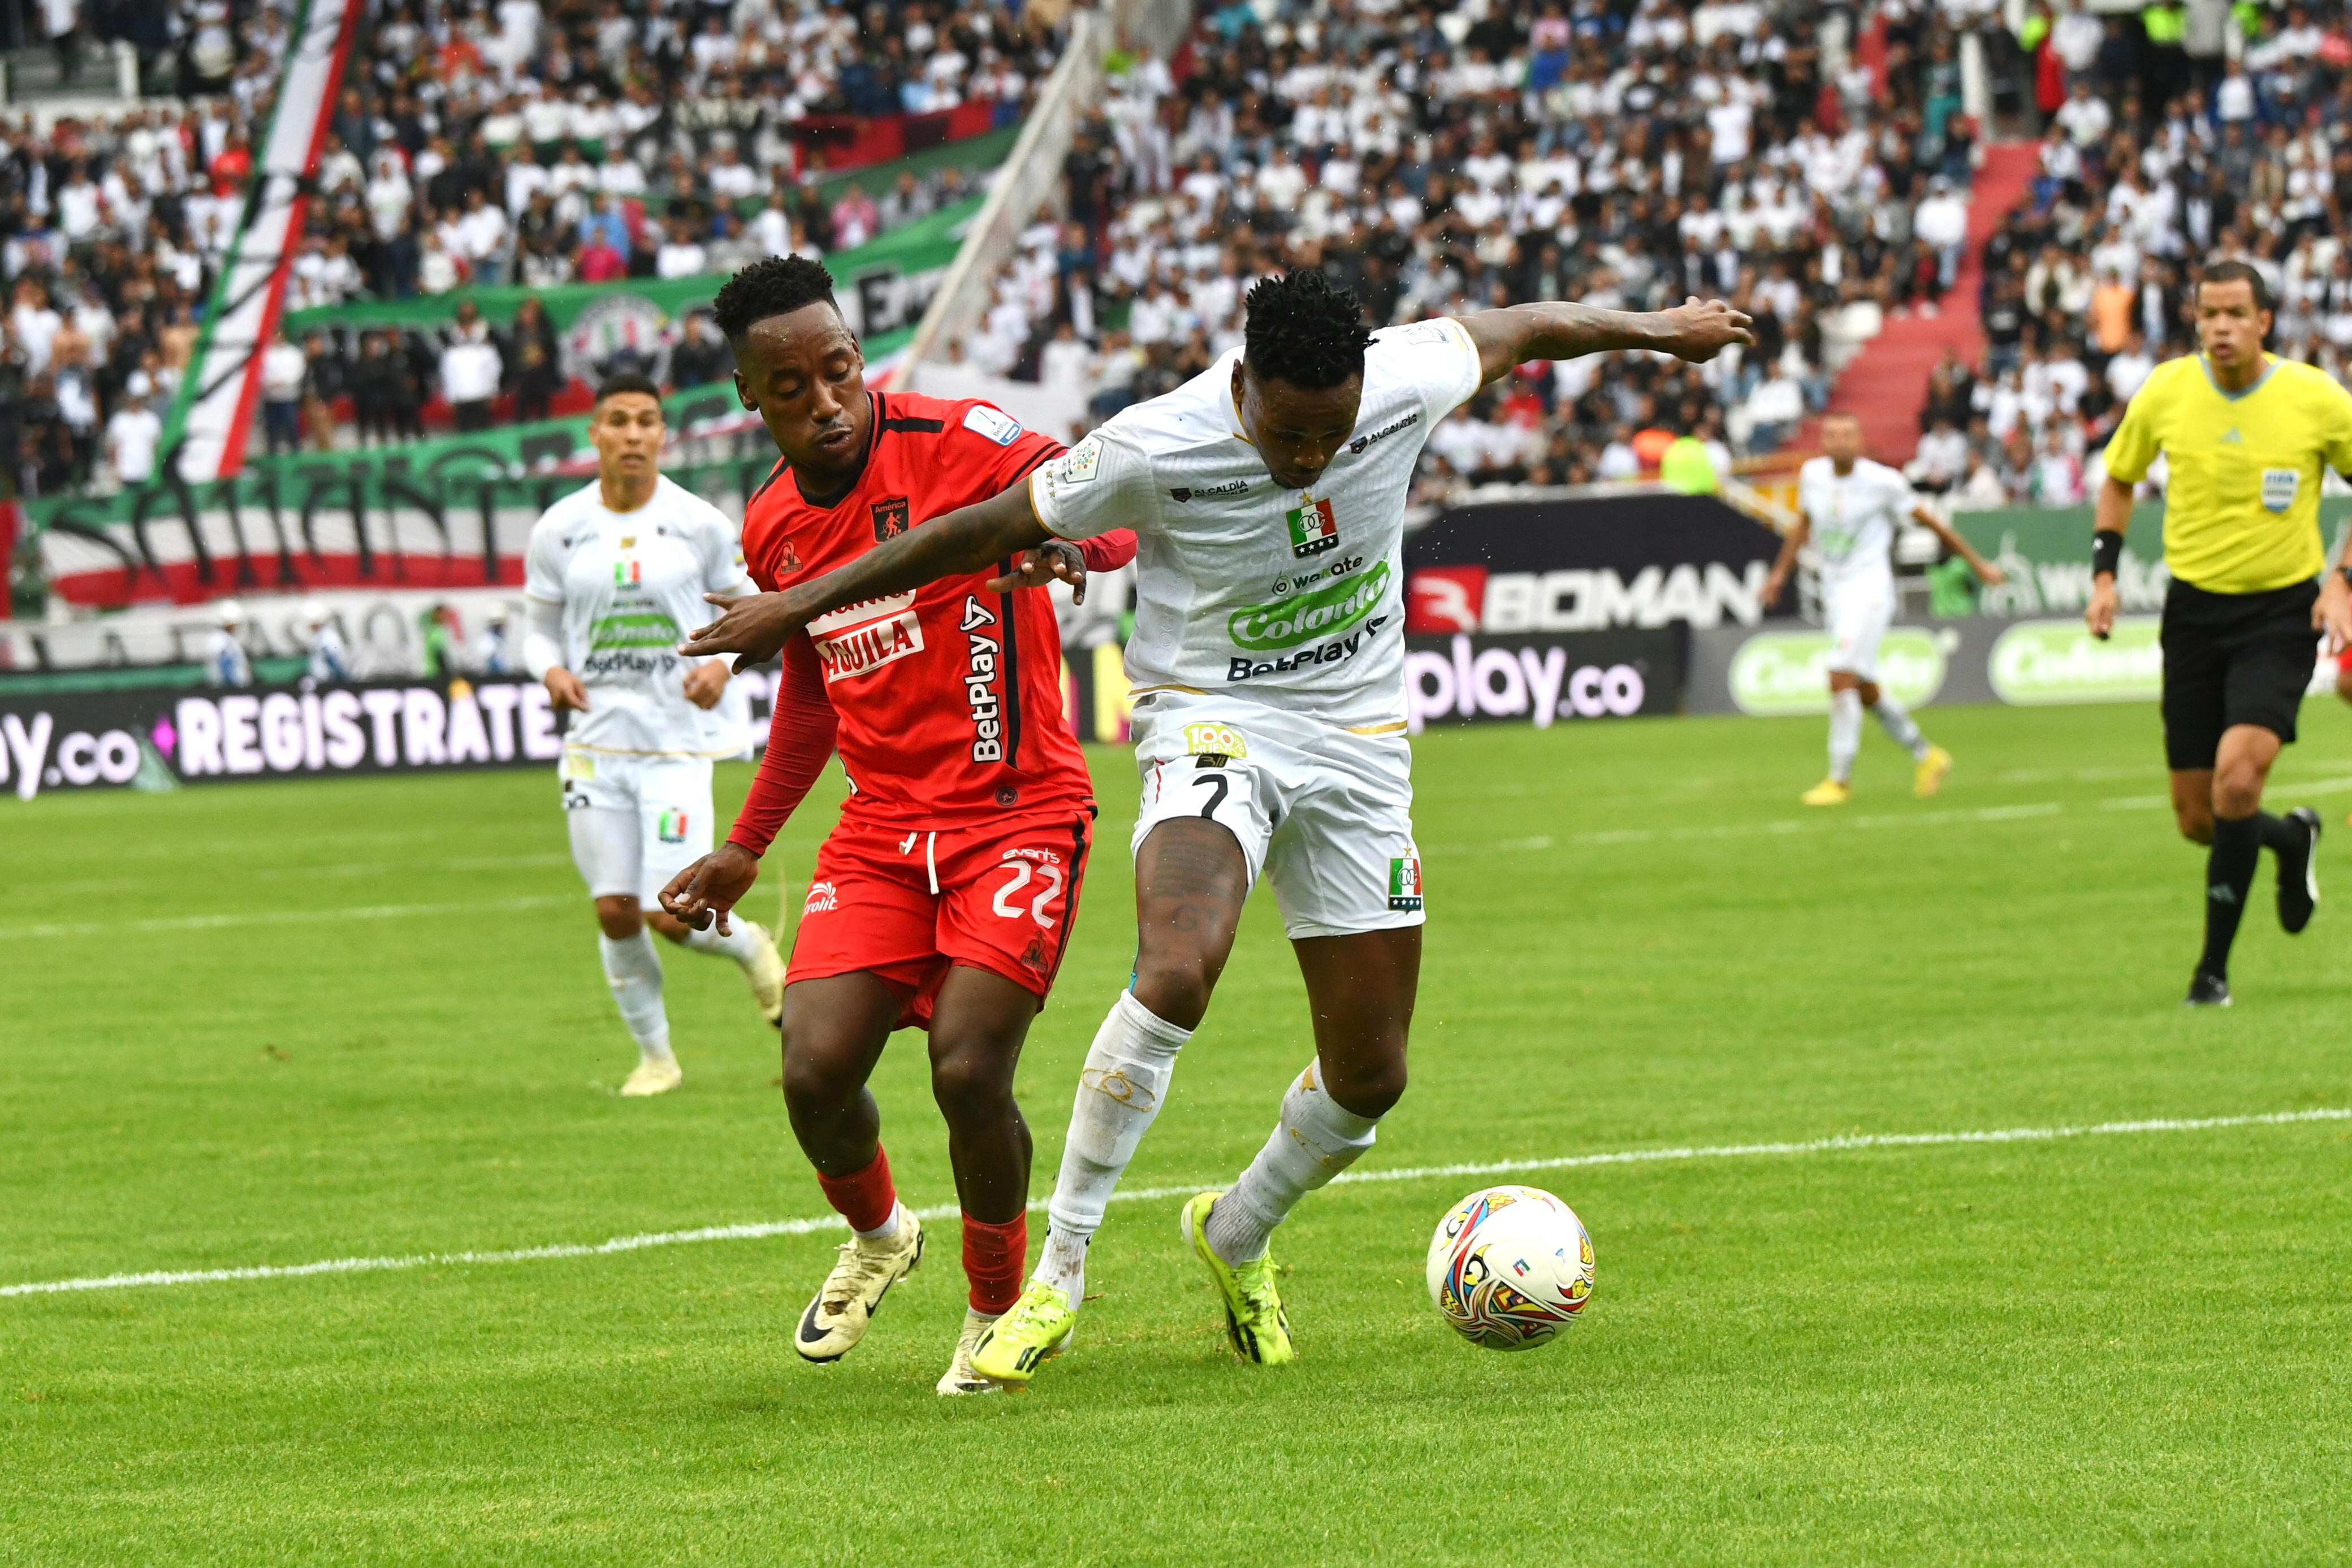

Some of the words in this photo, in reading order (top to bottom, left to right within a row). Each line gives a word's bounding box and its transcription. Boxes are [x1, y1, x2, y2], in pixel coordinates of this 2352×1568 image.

[875, 501, 906, 513] América
[1480, 560, 1769, 634] BOMAN
[1226, 631, 1361, 681] BetPlay
[964, 634, 1002, 763] BetPlay
[0, 711, 141, 802] y.co
[1002, 847, 1060, 864] events
[804, 896, 837, 916] rolit
[992, 859, 1063, 929] 22
